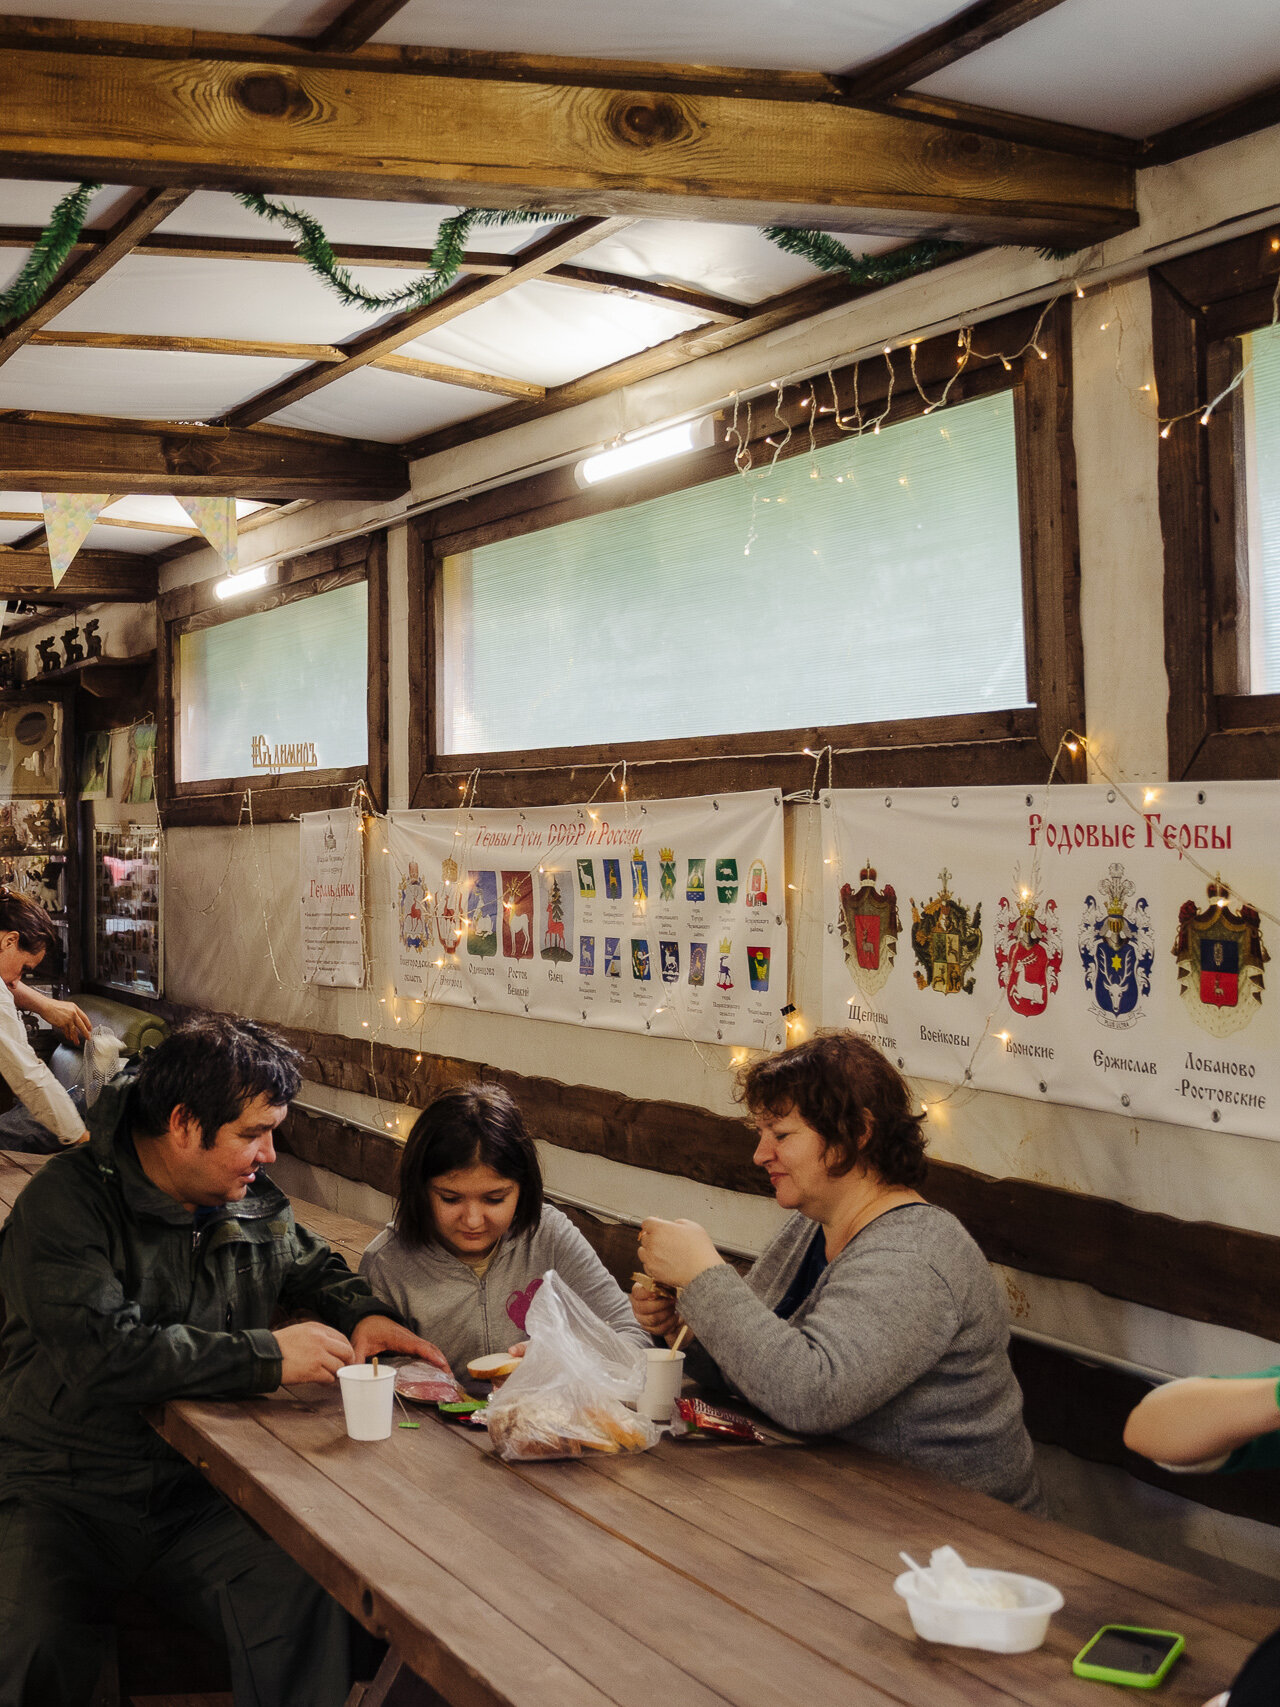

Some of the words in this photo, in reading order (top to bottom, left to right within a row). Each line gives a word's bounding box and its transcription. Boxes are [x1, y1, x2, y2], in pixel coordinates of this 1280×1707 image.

[475, 826, 512, 851] Гербы
[511, 824, 543, 853] Руси,
[547, 822, 586, 846] СССР
[586, 828, 598, 845] и
[597, 822, 643, 846] России
[1028, 813, 1136, 855] Родовые
[1143, 813, 1232, 860] Гербы
[310, 879, 356, 902] Геральдика
[507, 966, 528, 980] Ростов
[507, 983, 530, 997] Великий
[848, 1004, 889, 1024] Щепины
[920, 1024, 970, 1048] Воейковы
[1006, 1037, 1055, 1060] Вронские
[1184, 1051, 1256, 1078] Лобаново
[1174, 1078, 1267, 1110] -Ростовские
